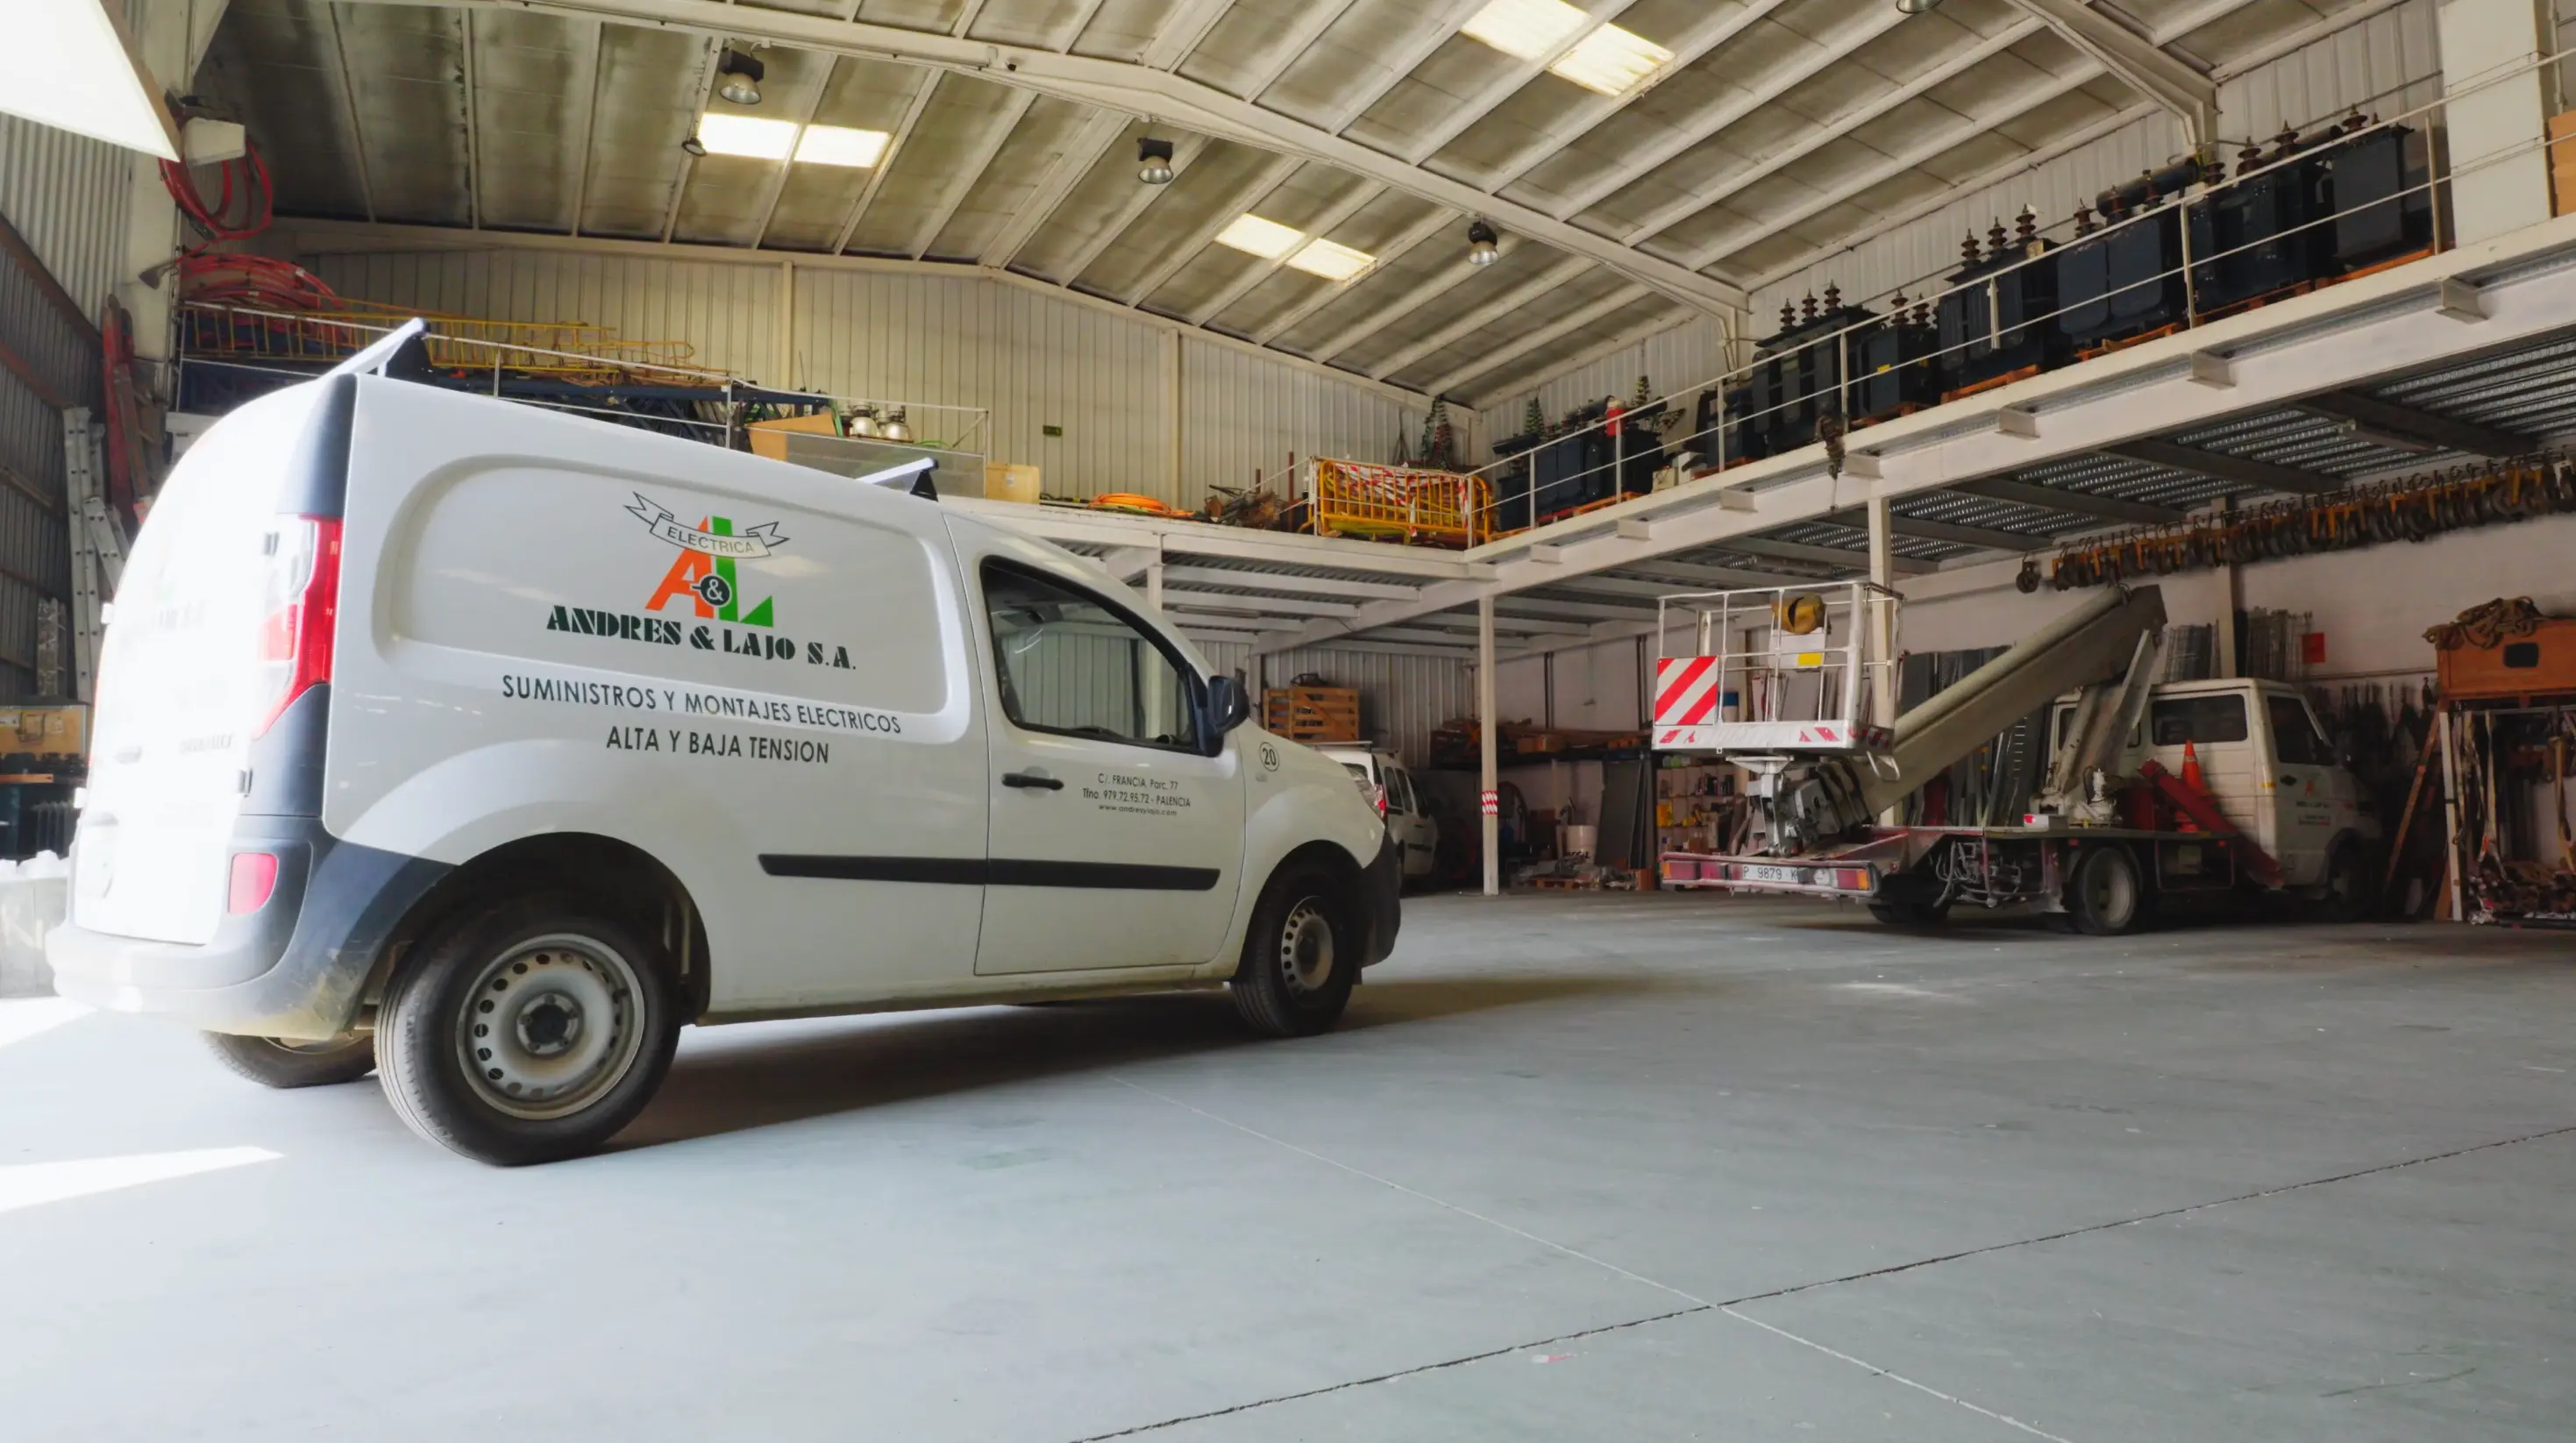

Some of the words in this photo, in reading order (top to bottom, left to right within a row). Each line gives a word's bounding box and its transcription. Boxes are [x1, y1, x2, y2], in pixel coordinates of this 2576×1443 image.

[666, 526, 755, 554] ELECTRICA
[546, 605, 682, 646] ANDRES
[690, 625, 715, 651] &
[723, 629, 796, 661] LAJO
[807, 643, 857, 671] S.A.
[502, 674, 657, 711] SUMINISTROS
[664, 691, 675, 712] Y
[685, 693, 791, 723] MONTAJES
[799, 705, 902, 735] ELECTRICOS
[606, 726, 660, 752] ALTA
[669, 730, 681, 754] Y
[689, 733, 743, 759] BAJA
[749, 736, 829, 764] TENSION
[1263, 748, 1277, 766] 20
[1170, 781, 1178, 790] 77
[1156, 795, 1191, 807] PALENCIA
[1744, 866, 1749, 878] P
[1757, 867, 1783, 880] 9879
